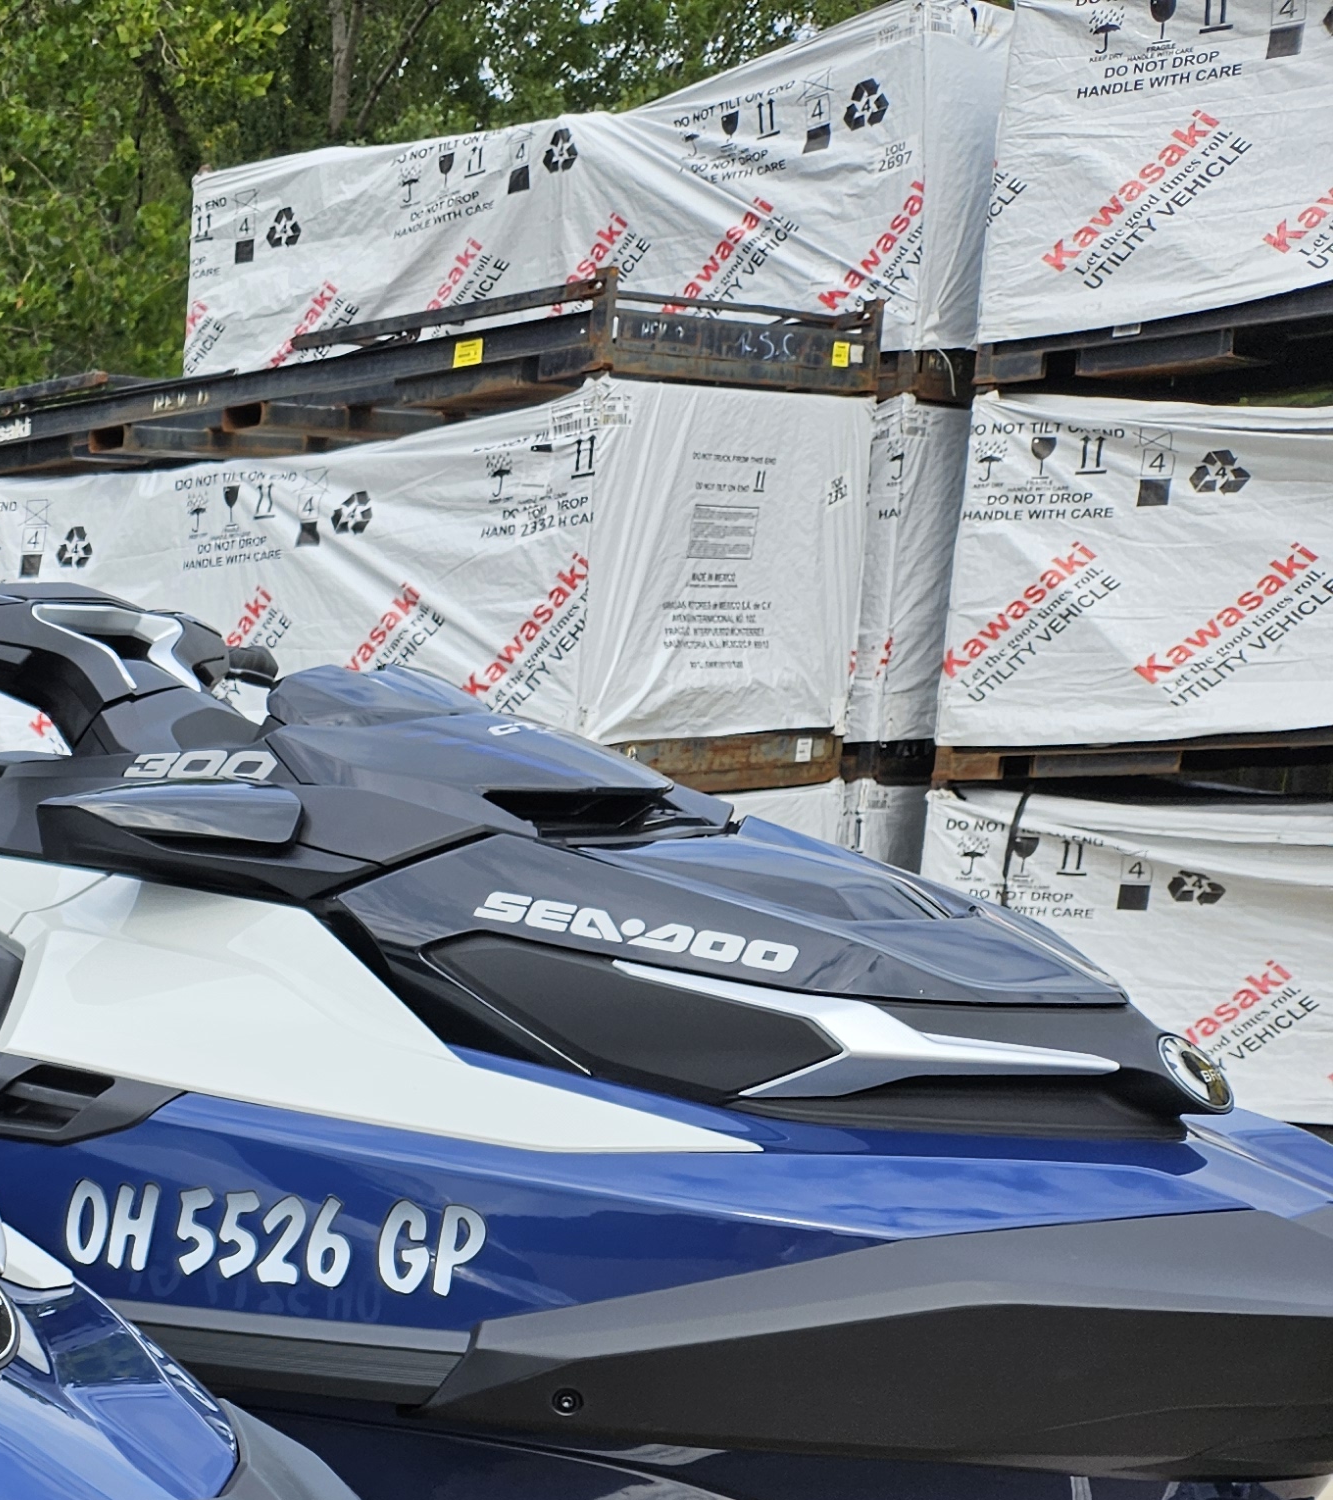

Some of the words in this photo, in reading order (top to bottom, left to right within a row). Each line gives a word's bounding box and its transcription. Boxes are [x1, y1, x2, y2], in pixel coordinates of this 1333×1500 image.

[1279, 0, 1298, 18] 4
[1104, 65, 1128, 79] DO
[1133, 58, 1168, 75] NOT
[1172, 50, 1220, 69] DROP
[1076, 78, 1144, 99] HANDLE
[1150, 71, 1191, 89] WITH
[1195, 63, 1243, 82] CARE
[692, 106, 715, 123] NOT
[718, 96, 743, 114] TILT
[811, 98, 824, 120] 4
[861, 101, 872, 113] 4
[885, 142, 907, 157] LOU
[757, 159, 787, 177] CARE
[878, 150, 914, 173] 2697
[447, 190, 480, 207] DROP
[1042, 108, 1221, 272] Kawasaki
[1073, 249, 1101, 277] Let
[1100, 227, 1126, 251] the
[1124, 196, 1162, 230] good
[1158, 157, 1203, 201] times
[1201, 129, 1234, 159] roll.
[1083, 217, 1158, 291] UTILITY
[1155, 136, 1253, 218] VEHICLE
[239, 217, 249, 234] 4
[992, 422, 1025, 434] NOT
[1032, 421, 1062, 433] TILT
[1149, 452, 1165, 473] 4
[1214, 466, 1227, 479] 4
[175, 478, 192, 491] DO
[195, 474, 218, 487] NOT
[302, 496, 314, 516] 4
[987, 494, 1010, 505] DO
[1014, 493, 1044, 505] NOT
[1047, 492, 1093, 504] DROP
[963, 509, 1024, 521] HANDLE
[1028, 508, 1073, 520] WITH
[1076, 507, 1115, 519] CARE
[26, 530, 40, 550] 4
[480, 523, 516, 538] HAND
[197, 543, 216, 555] DO
[217, 539, 237, 552] NOT
[238, 536, 267, 549] DROP
[183, 556, 223, 570] HANDLE
[225, 552, 251, 565] WITH
[253, 549, 282, 562] CARE
[942, 540, 1097, 678] Kawasaki
[1007, 619, 1039, 651] good
[1037, 589, 1074, 620] times
[1074, 566, 1105, 591] roll.
[1133, 541, 1320, 685] Kawasaki
[1190, 653, 1216, 675] the
[1215, 626, 1252, 658] good
[1251, 595, 1294, 628] times
[1294, 569, 1327, 596] roll.
[967, 640, 1037, 703] UTILITY
[1035, 575, 1122, 643] VEHICLE
[499, 660, 551, 713] TILITY
[1169, 649, 1248, 707] UTILITY
[123, 750, 278, 781] 300
[946, 818, 970, 832] DO
[974, 819, 1006, 833] NOT
[1128, 860, 1145, 879] 4
[1030, 891, 1074, 903] DROP
[1053, 907, 1095, 920] CARE
[1230, 1009, 1271, 1038] times
[1271, 986, 1302, 1010] roll.
[1228, 995, 1321, 1060] VEHICLE
[64, 1178, 162, 1272] OH
[175, 1185, 352, 1289] 5526
[377, 1200, 488, 1298] GP
